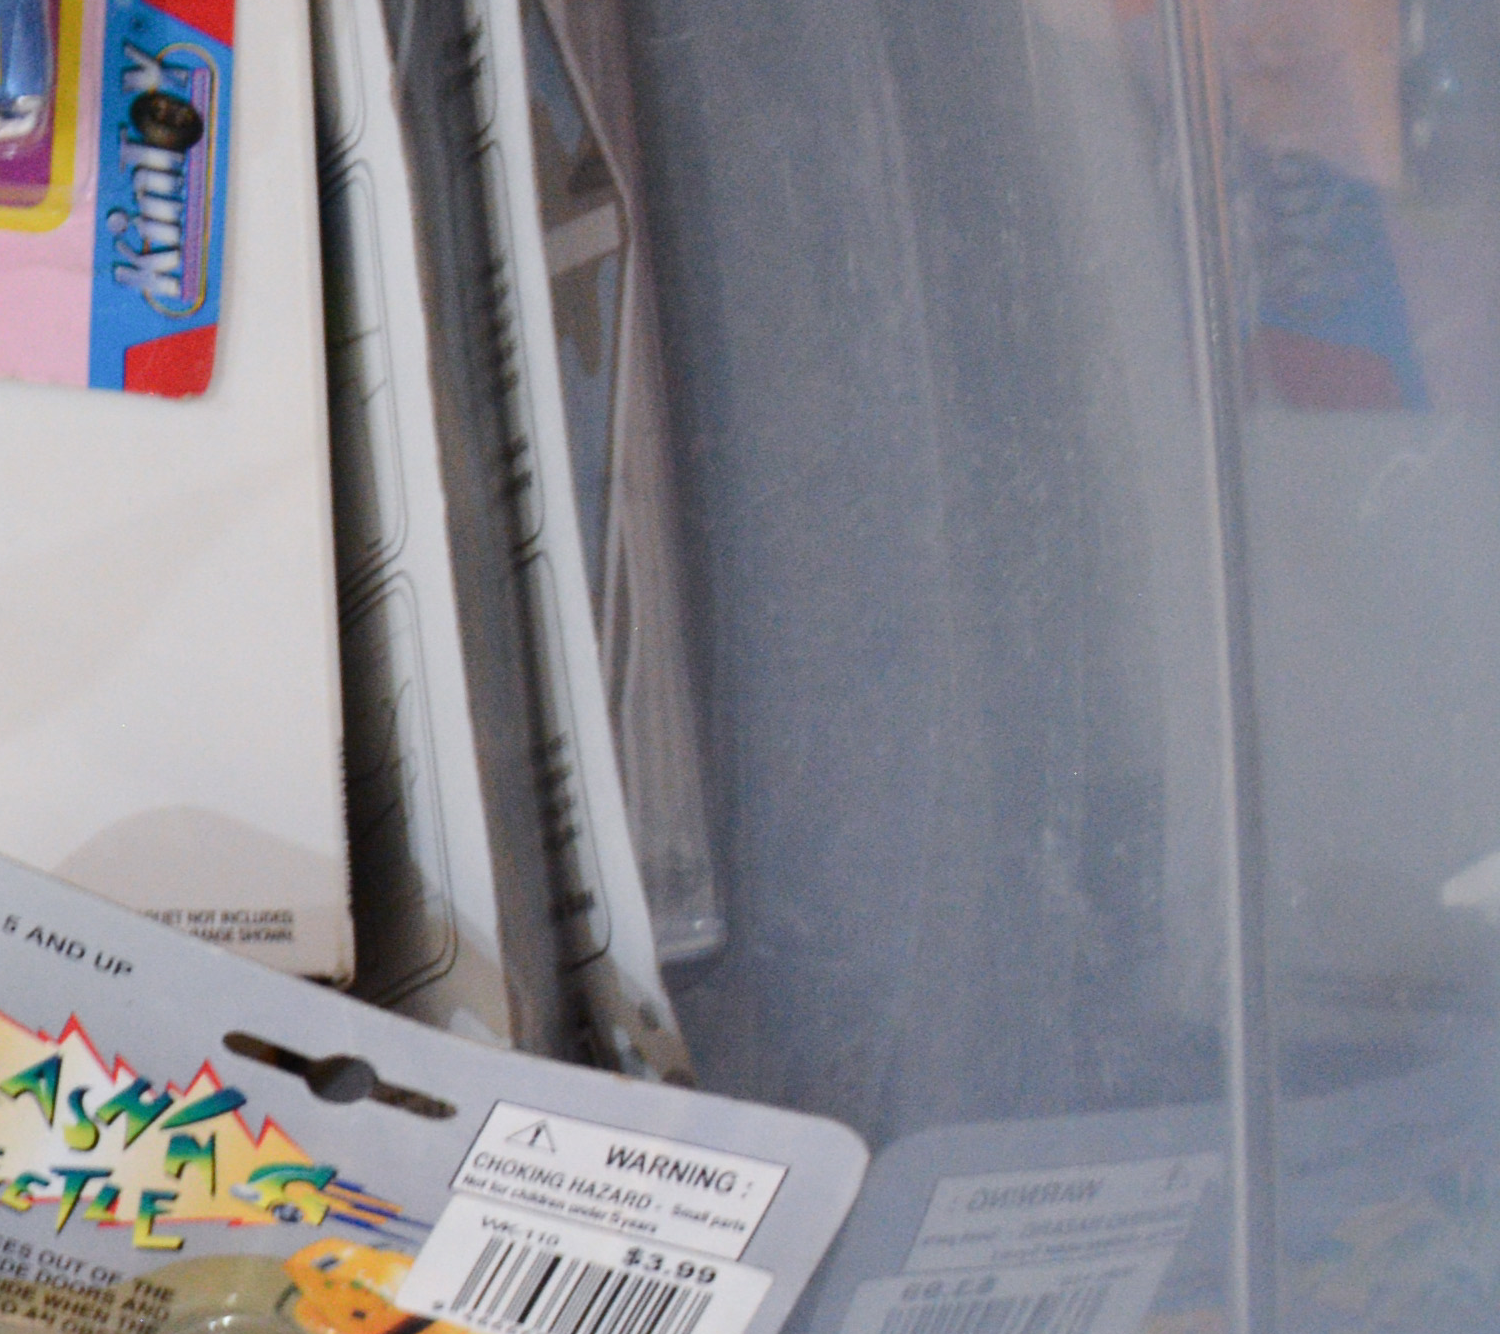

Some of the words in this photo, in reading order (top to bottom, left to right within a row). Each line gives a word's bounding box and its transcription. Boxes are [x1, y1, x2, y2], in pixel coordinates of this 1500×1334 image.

[1, 913, 21, 936] 5
[24, 920, 87, 963] AND
[92, 947, 135, 979] UP
[471, 1143, 568, 1194] CHOKING
[566, 1170, 654, 1218] HAZARD
[602, 1134, 739, 1205] WARNING
[478, 1211, 562, 1251] WK-110
[33, 1263, 117, 1311] DOORS
[36, 1245, 85, 1278] OUT
[89, 1262, 124, 1289] OF
[128, 1275, 175, 1305] THE
[620, 1241, 718, 1294] $3.99
[40, 1288, 111, 1329] WHEN
